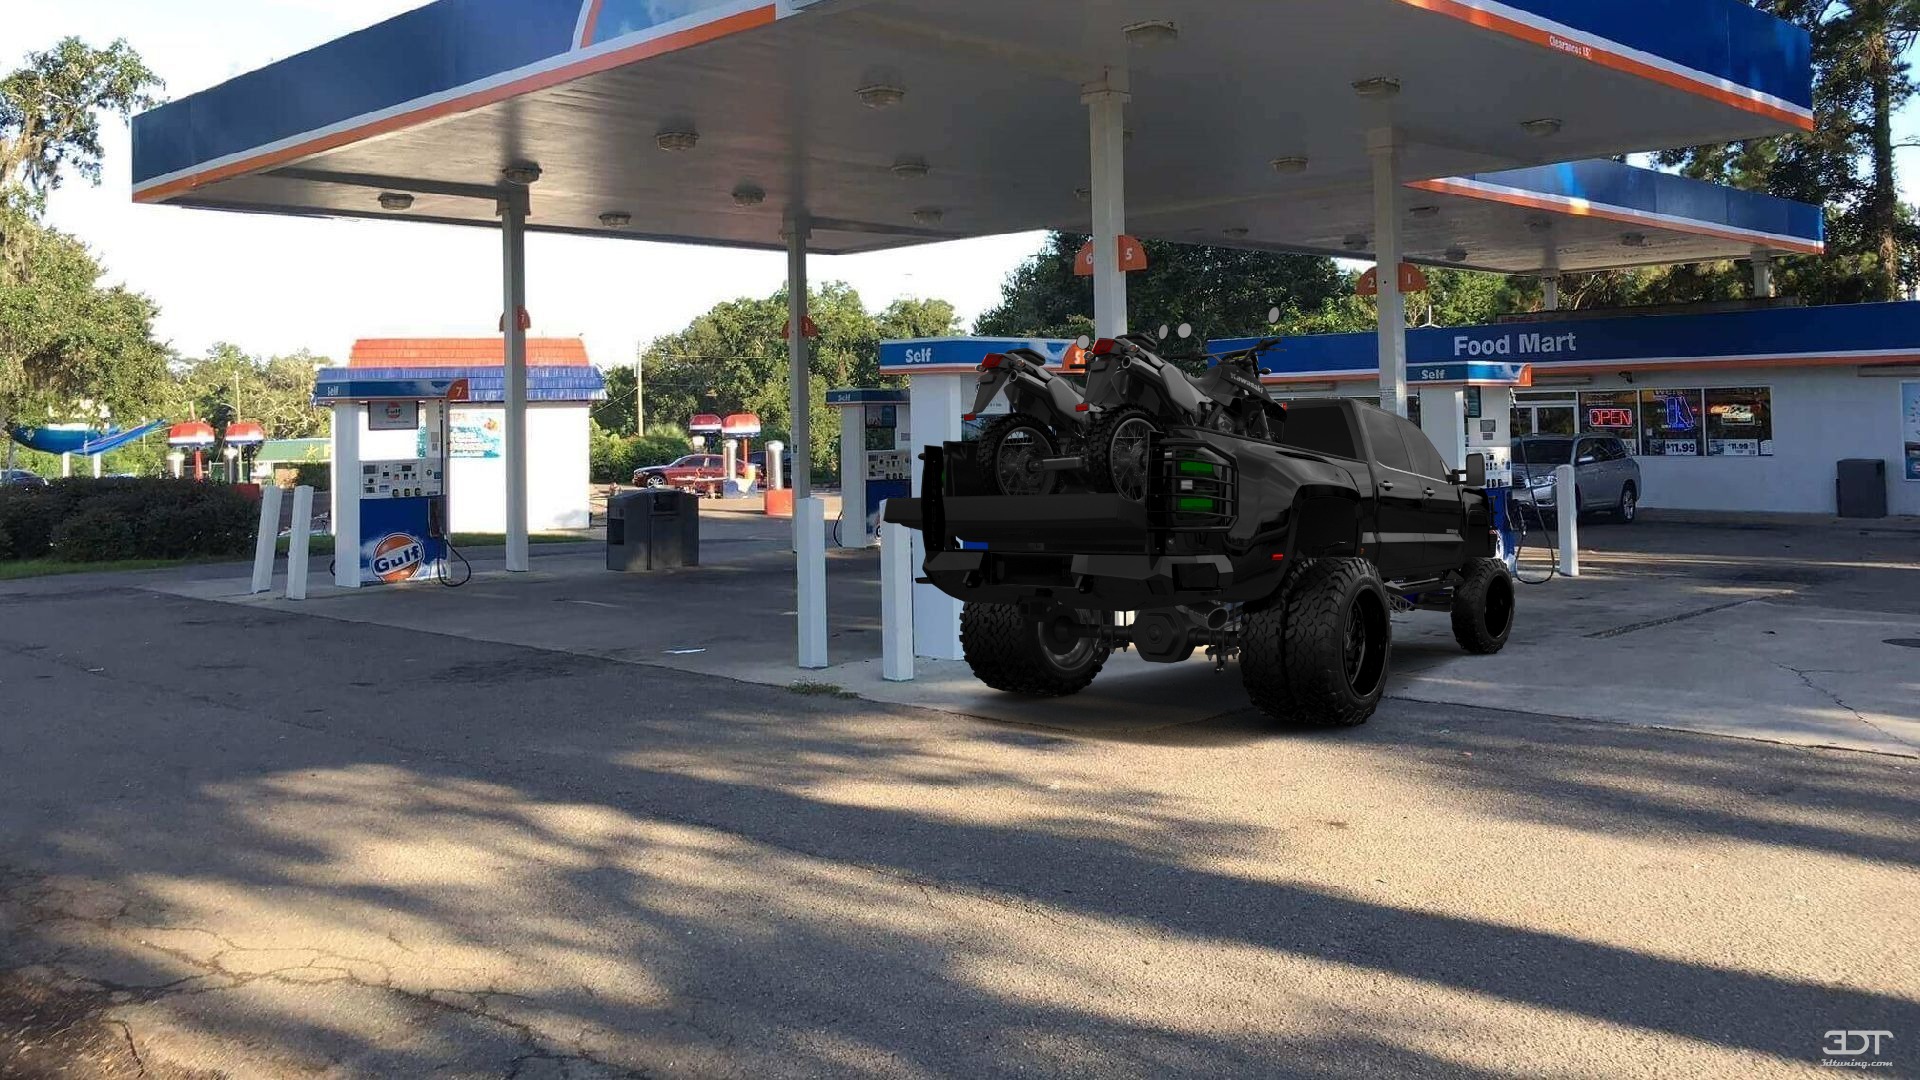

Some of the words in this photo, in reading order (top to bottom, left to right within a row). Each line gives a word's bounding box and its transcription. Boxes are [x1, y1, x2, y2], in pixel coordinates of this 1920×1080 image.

[1085, 252, 1093, 265] 6
[1125, 247, 1133, 260] 5
[1367, 277, 1376, 288] 2
[1407, 273, 1412, 285] 1
[1454, 334, 1510, 356] Food
[1519, 332, 1577, 354] Mart
[905, 347, 932, 363] Self
[1421, 369, 1446, 380] Self
[456, 386, 463, 397] 7
[1591, 410, 1632, 426] OPEN
[1666, 443, 1695, 453] $11.99
[374, 545, 419, 573] Gulf
